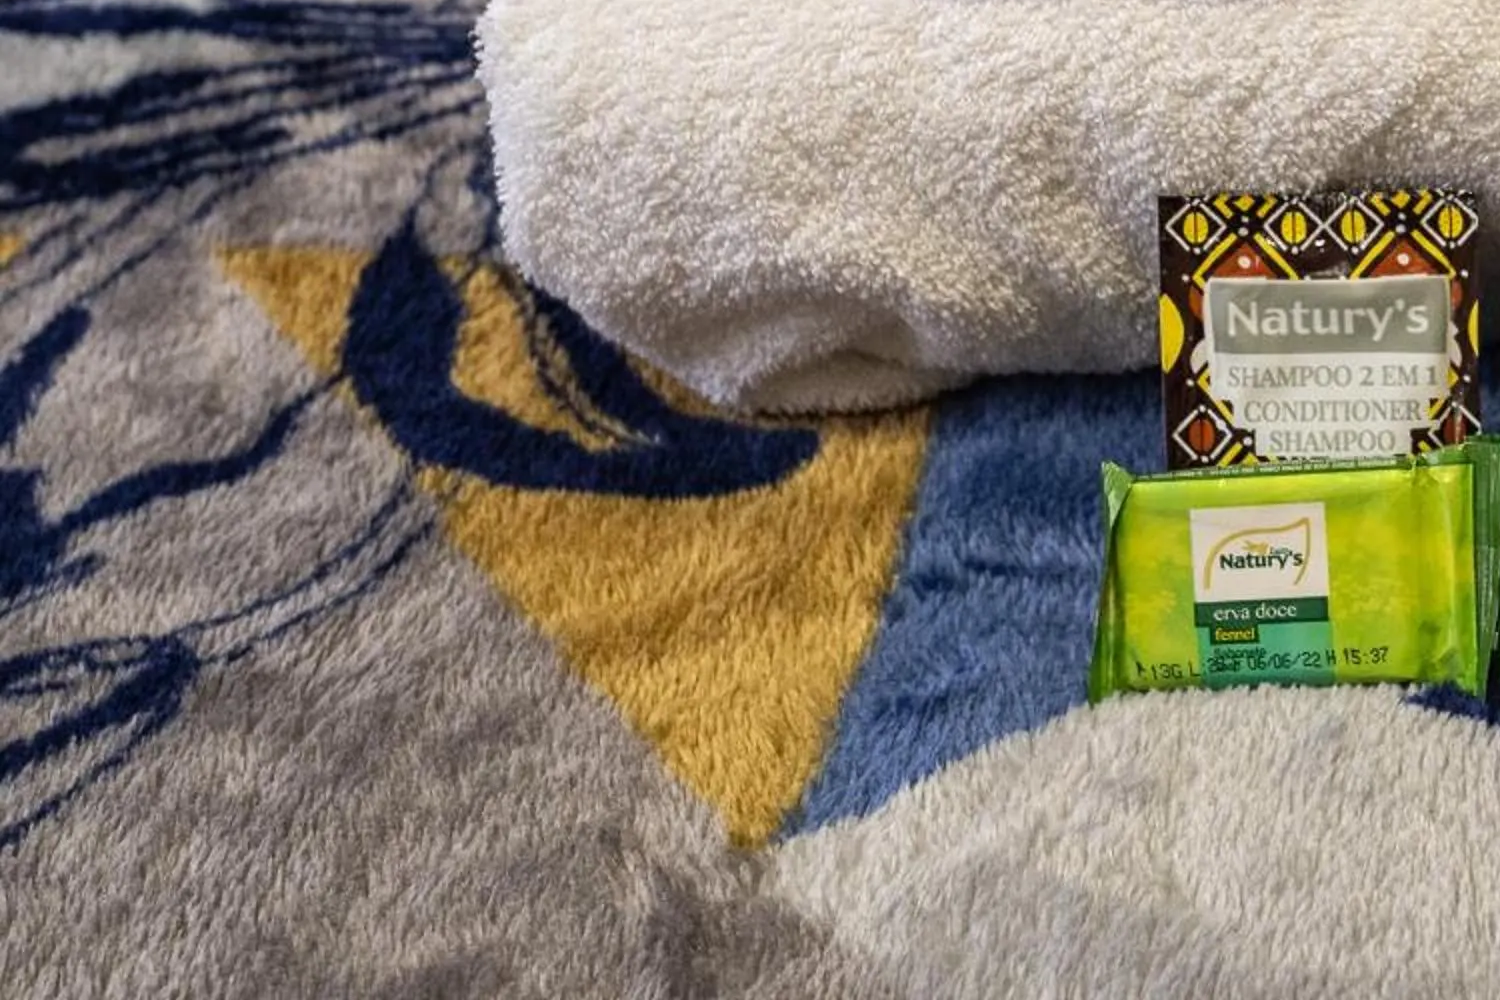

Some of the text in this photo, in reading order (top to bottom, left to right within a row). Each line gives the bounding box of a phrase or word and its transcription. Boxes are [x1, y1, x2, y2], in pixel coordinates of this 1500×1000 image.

[1227, 299, 1430, 342] Natury's
[1227, 364, 1439, 388] SHAMPOO 2 EM 1
[1243, 399, 1422, 424] CONDITIONER
[1269, 429, 1397, 453] SHAMPOO
[1219, 551, 1305, 570] Natury's
[1213, 602, 1297, 620] erva doce
